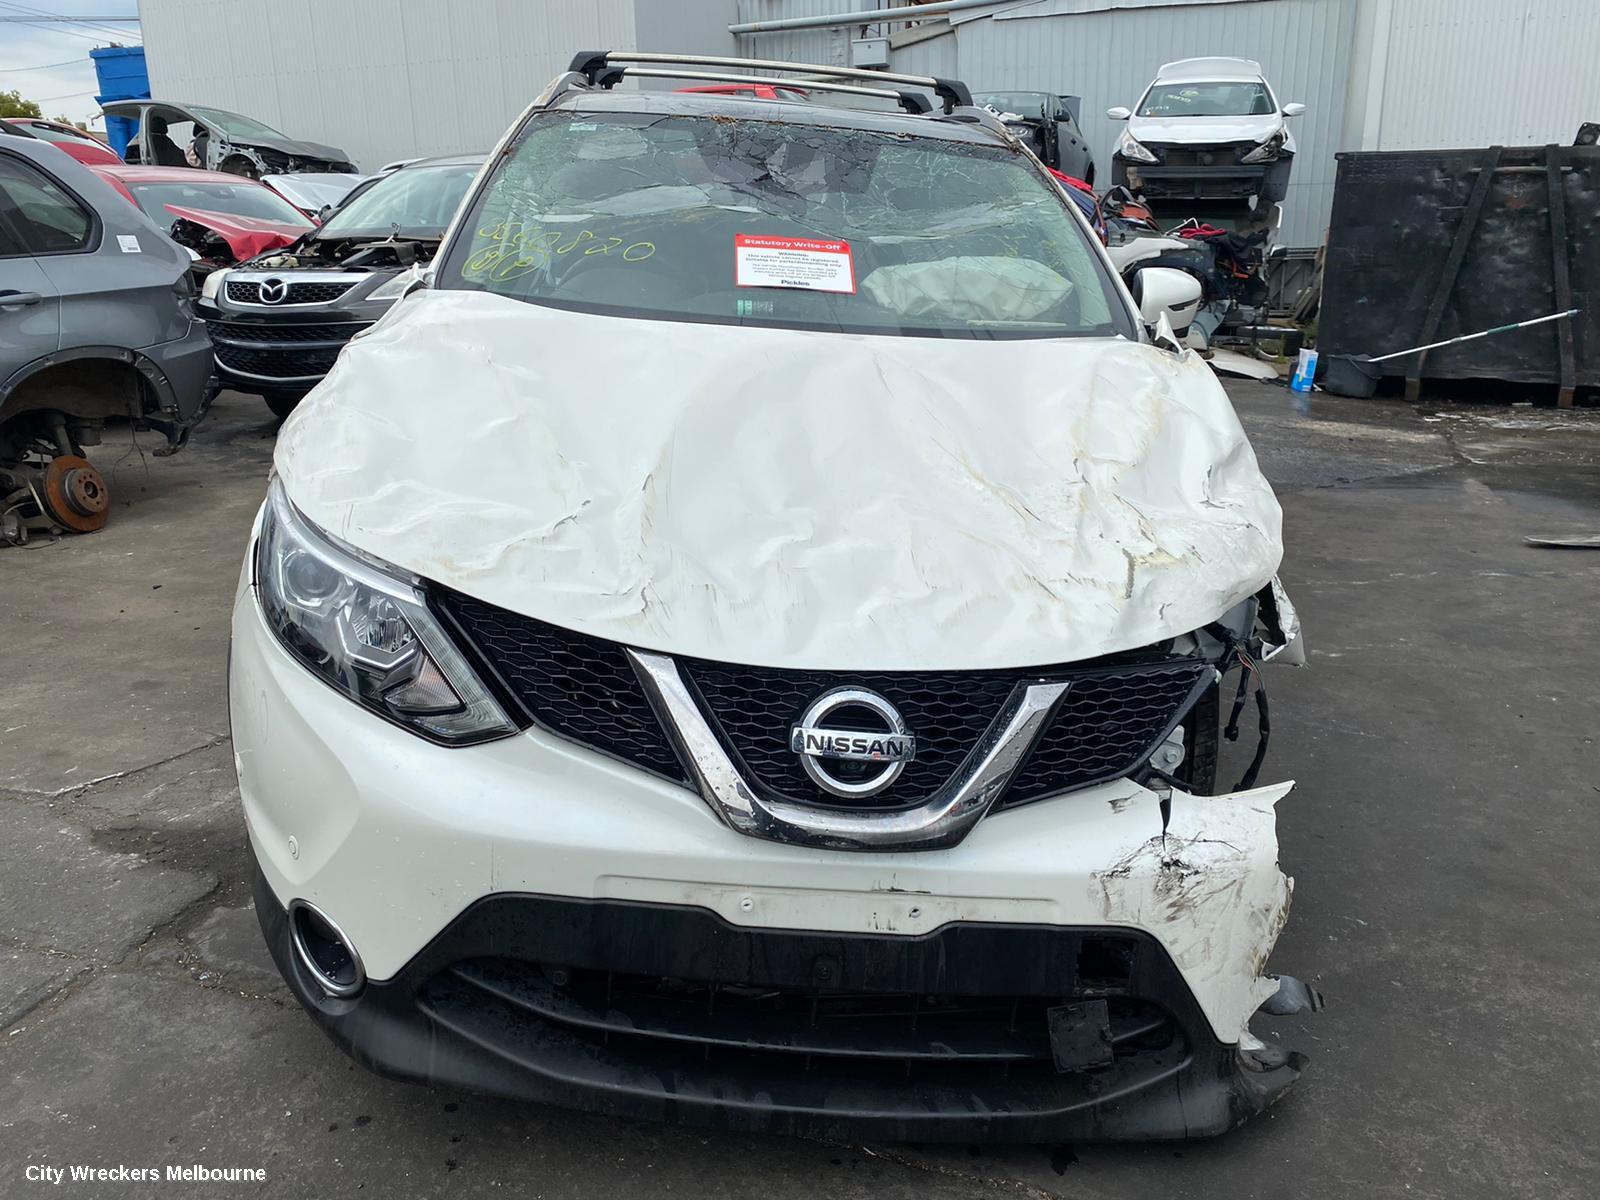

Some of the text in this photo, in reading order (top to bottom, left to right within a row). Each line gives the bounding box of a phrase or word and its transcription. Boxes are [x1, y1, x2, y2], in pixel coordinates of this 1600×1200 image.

[744, 238, 841, 251] Statutory Write-Off
[806, 734, 904, 756] NISSAN
